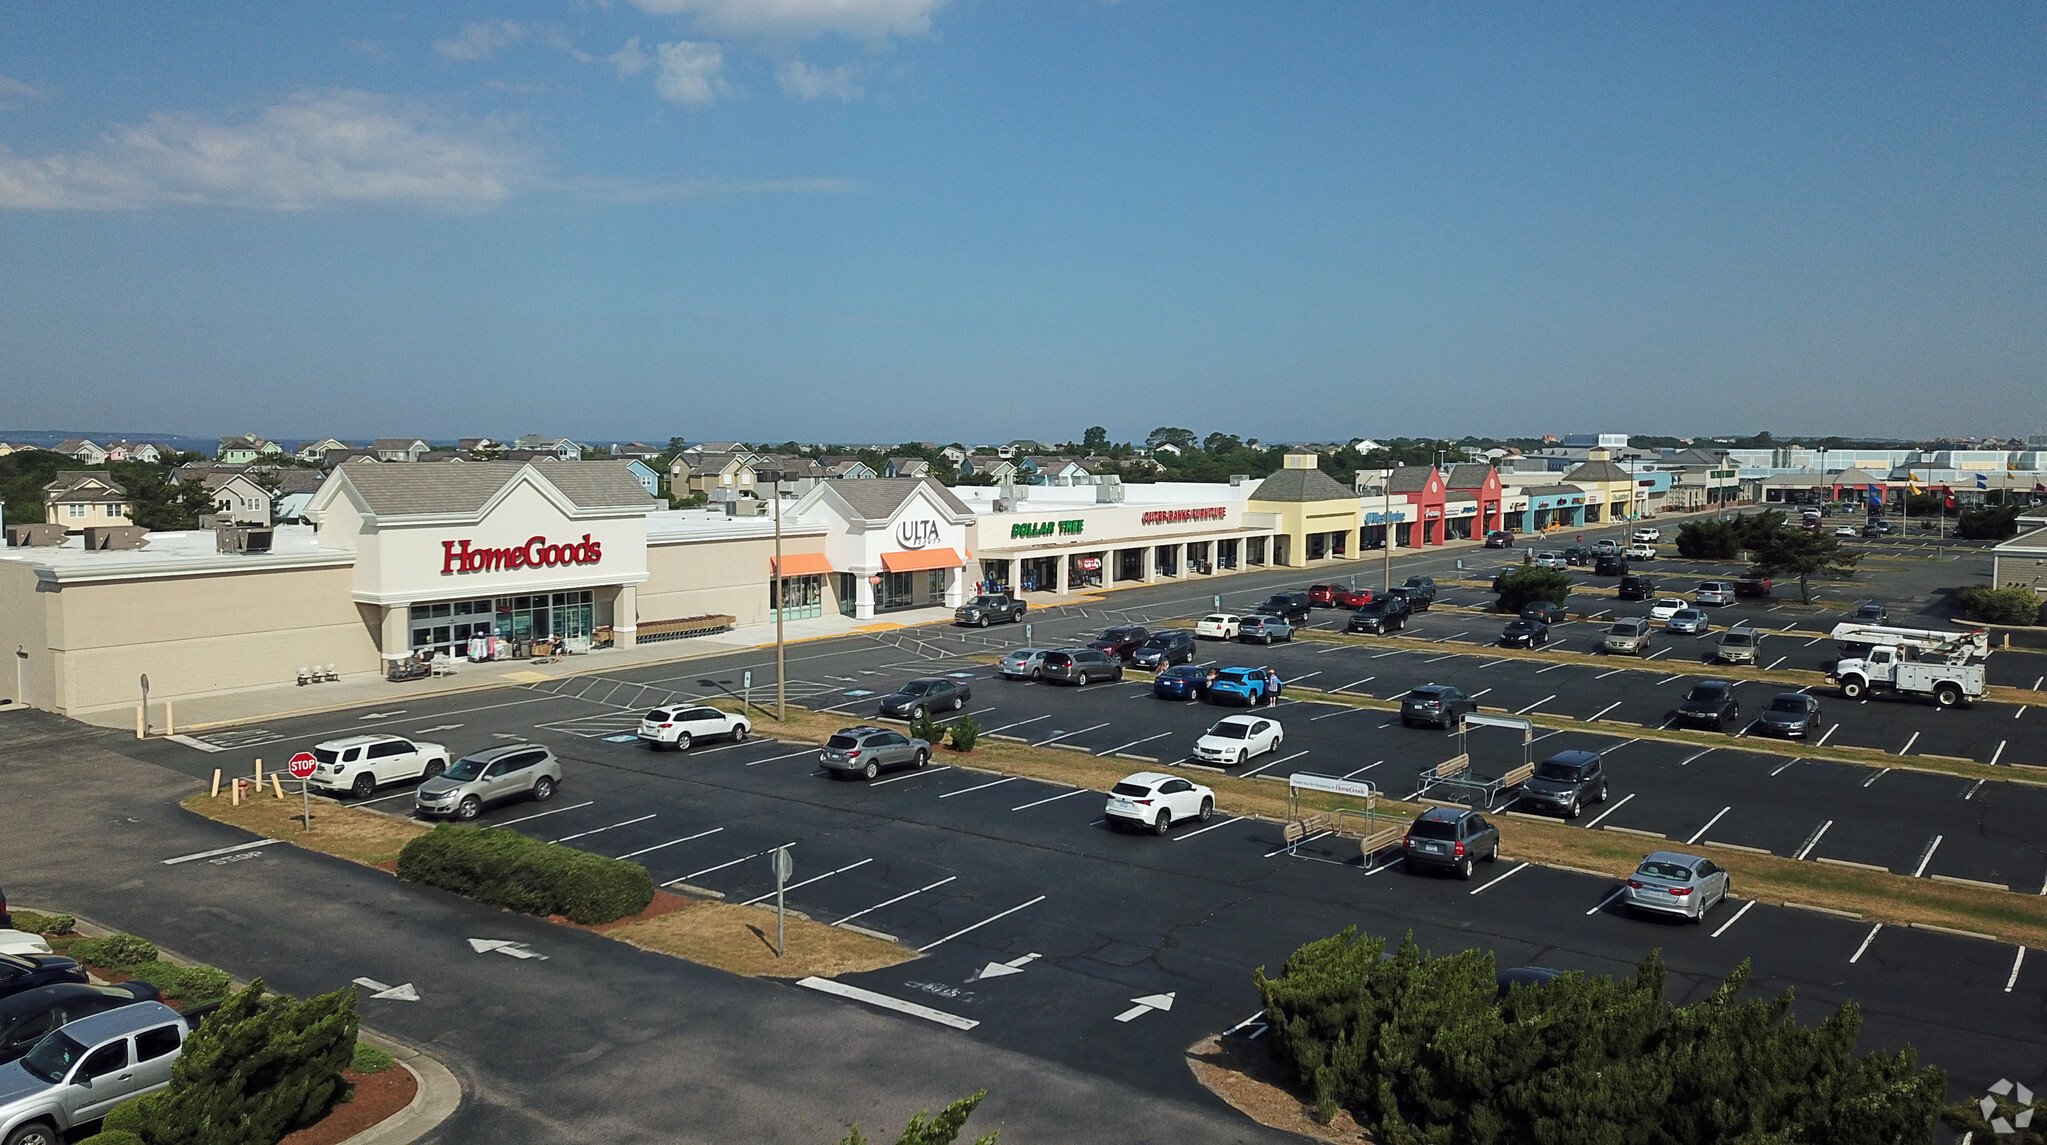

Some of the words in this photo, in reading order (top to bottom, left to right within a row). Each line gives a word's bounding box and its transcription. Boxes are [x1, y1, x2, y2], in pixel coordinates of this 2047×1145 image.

[1144, 511, 1168, 524] OUTER
[1169, 509, 1191, 521] BANKS
[1192, 507, 1226, 519] FURNITURE
[902, 520, 939, 541] ULTA
[1012, 521, 1055, 537] DOLLAR
[1058, 519, 1084, 533] TREE
[441, 533, 602, 574] HomeGoods
[291, 759, 315, 772] STOP
[1335, 784, 1365, 795] HomeGoods
